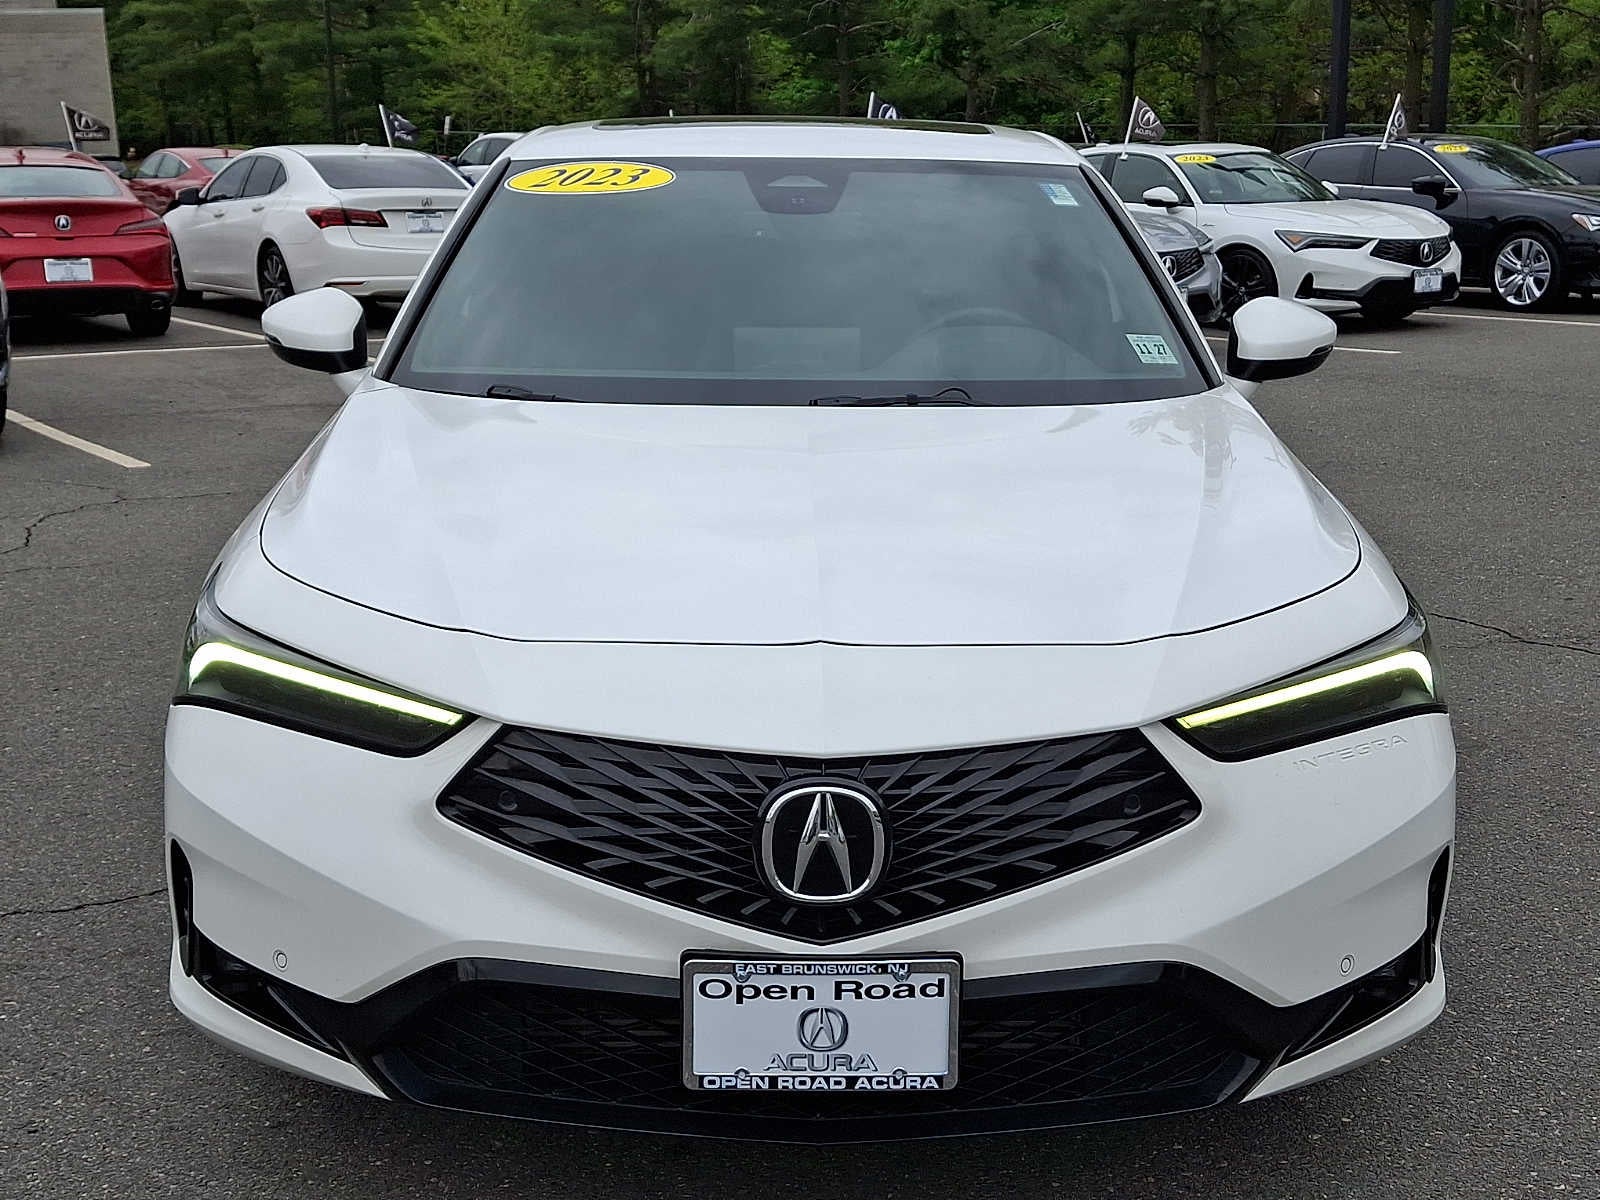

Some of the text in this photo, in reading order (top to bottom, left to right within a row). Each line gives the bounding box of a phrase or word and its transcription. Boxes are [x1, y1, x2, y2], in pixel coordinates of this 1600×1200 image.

[528, 167, 651, 188] 2023
[1136, 343, 1168, 356] 11 27
[1292, 734, 1409, 769] INTEGRA
[735, 963, 777, 976] EAST
[887, 963, 910, 976] NJ
[698, 976, 947, 1005] Open Road
[763, 1053, 878, 1072] ACURA
[702, 1075, 940, 1090] OPEN ROAD ACURA
